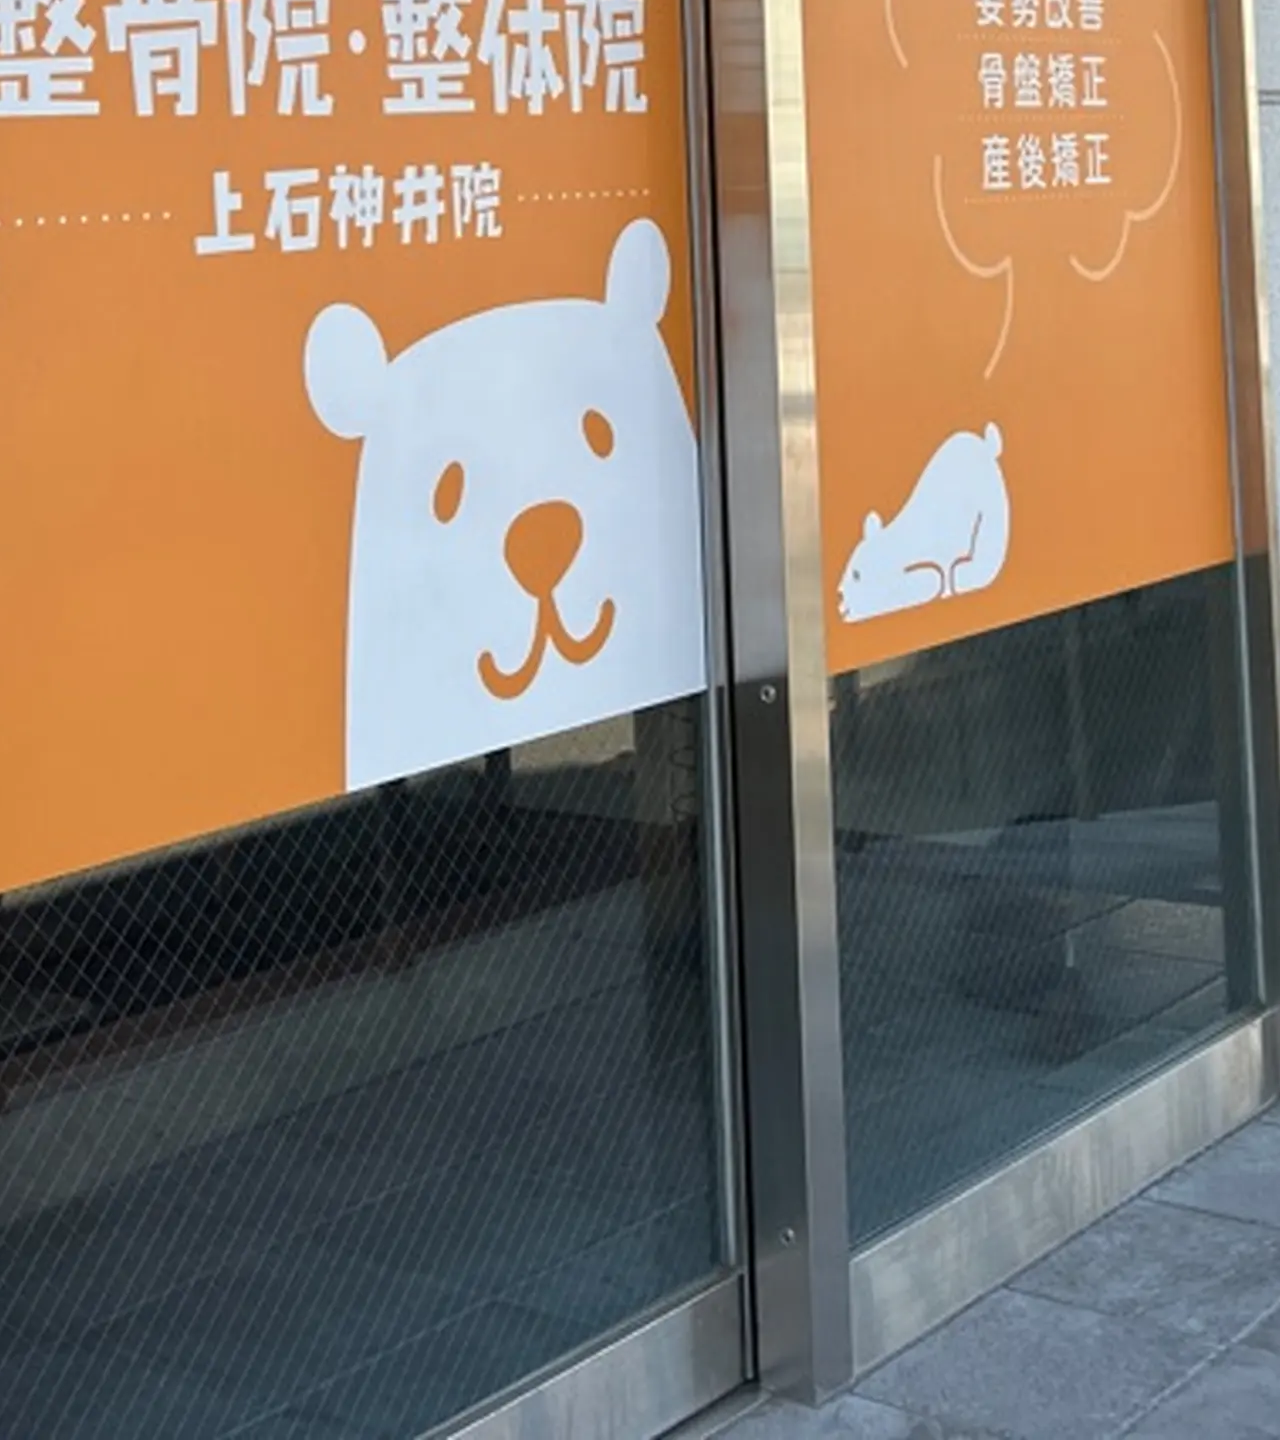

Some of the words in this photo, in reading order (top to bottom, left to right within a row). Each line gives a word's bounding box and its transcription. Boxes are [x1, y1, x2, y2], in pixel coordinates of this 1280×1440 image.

[978, 53, 1110, 110] 骨盤矯正
[981, 132, 1113, 192] 産後矯正
[194, 161, 504, 256] 上石神井院
